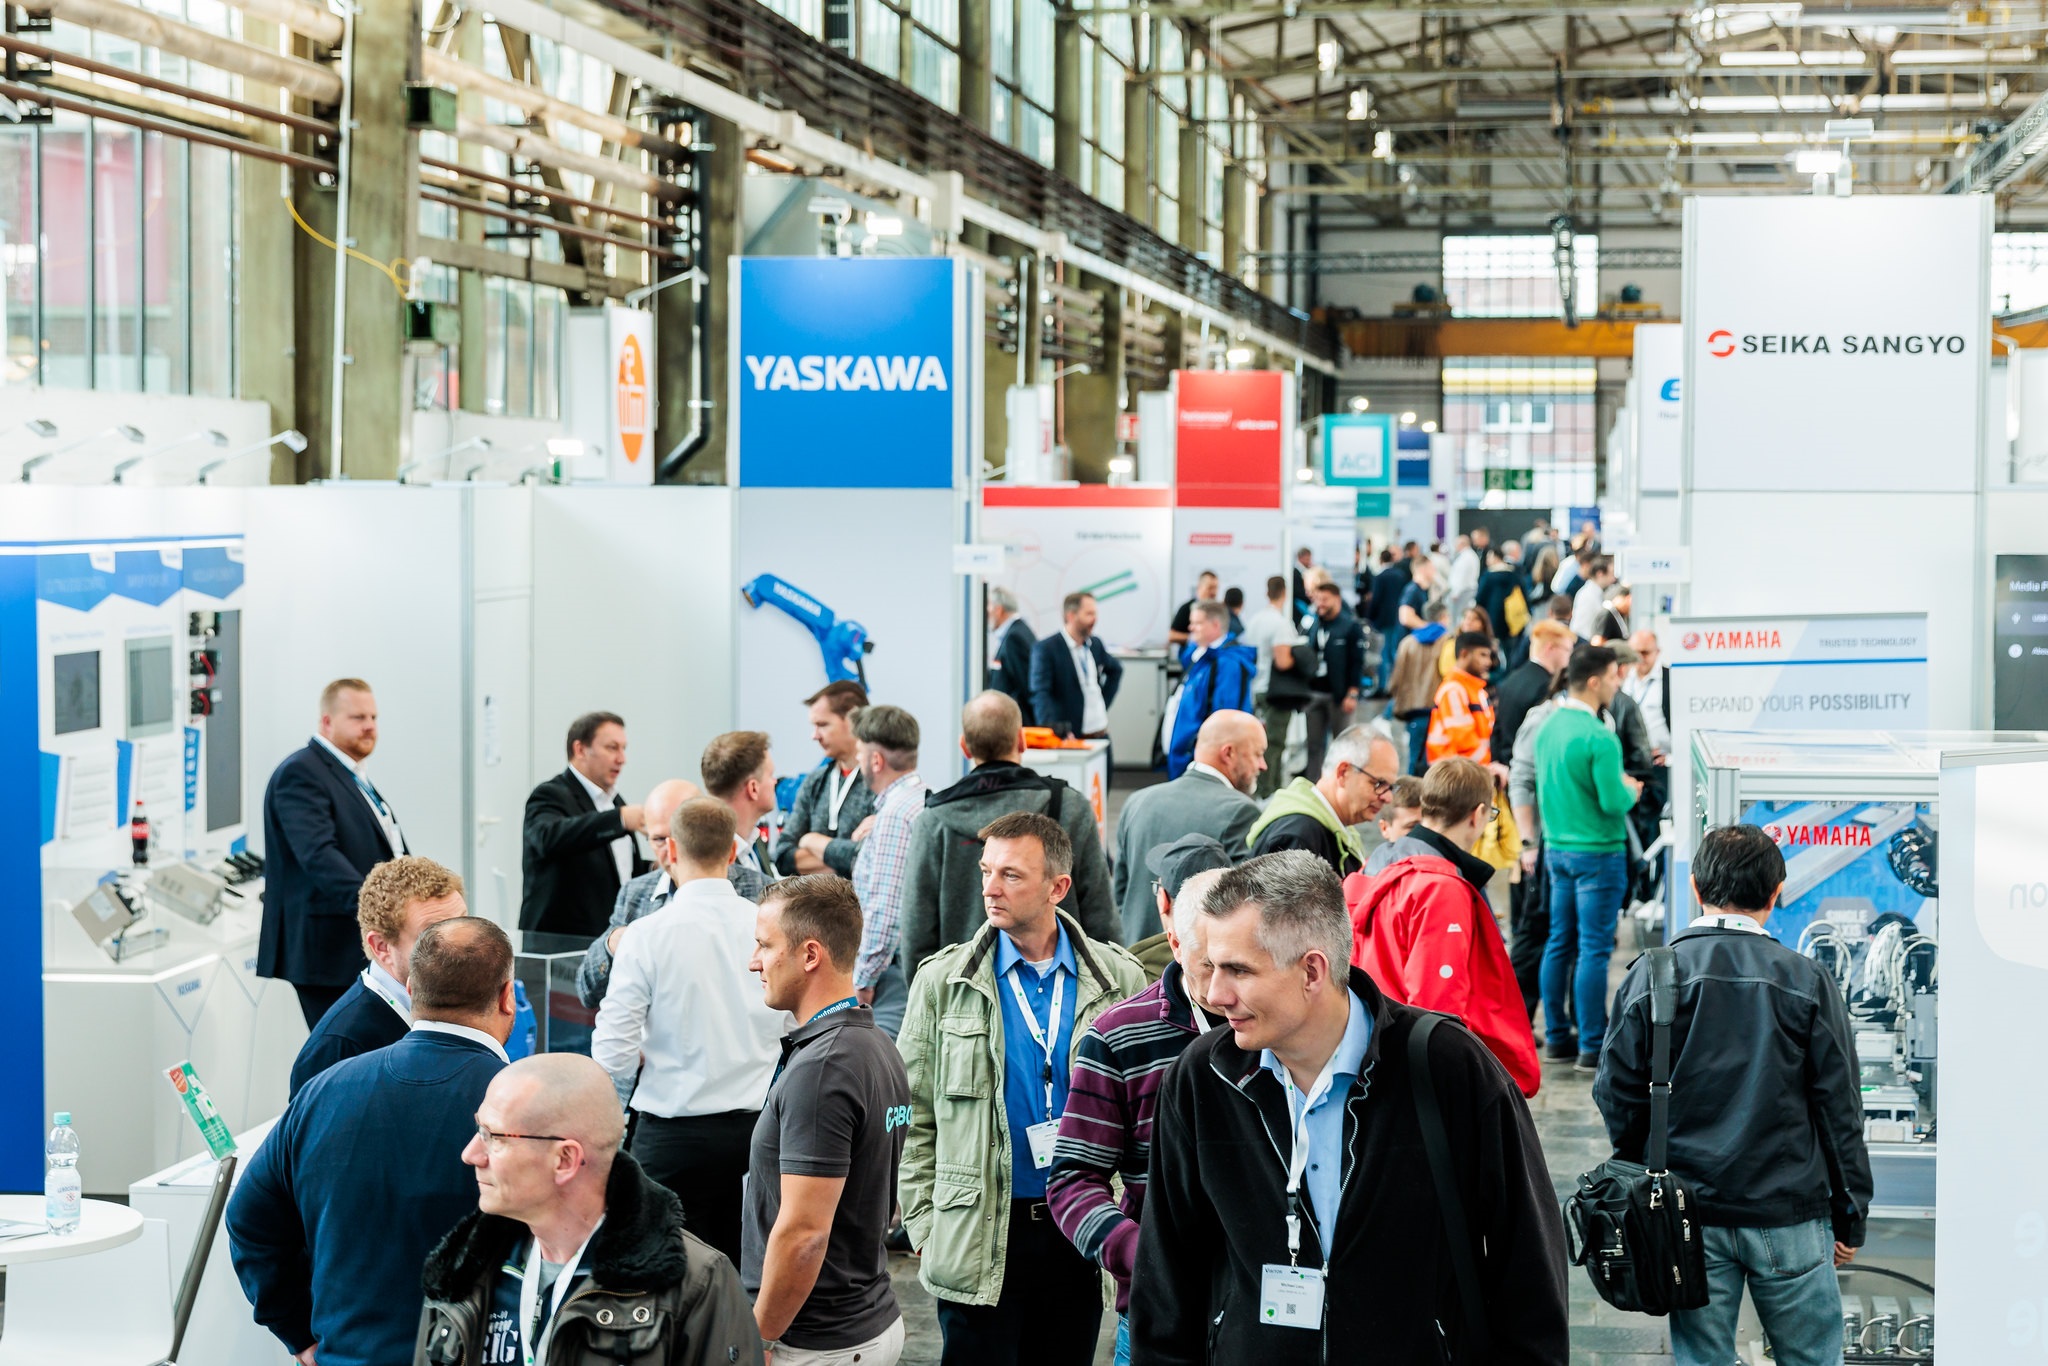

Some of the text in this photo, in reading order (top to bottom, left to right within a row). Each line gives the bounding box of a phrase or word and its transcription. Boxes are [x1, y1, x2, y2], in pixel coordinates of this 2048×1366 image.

[1742, 335, 1965, 354] SEIKA SANGYO
[745, 355, 948, 391] YASKAWA
[2009, 580, 2040, 592] Media
[1704, 631, 1917, 649] YAMAHA TRUSTED TECHNOLOGY
[1690, 693, 1911, 713] EXPAND YOUR POSSIBILITY
[1786, 825, 1872, 846] YAMAHA
[1825, 909, 1868, 922] SINGLE
